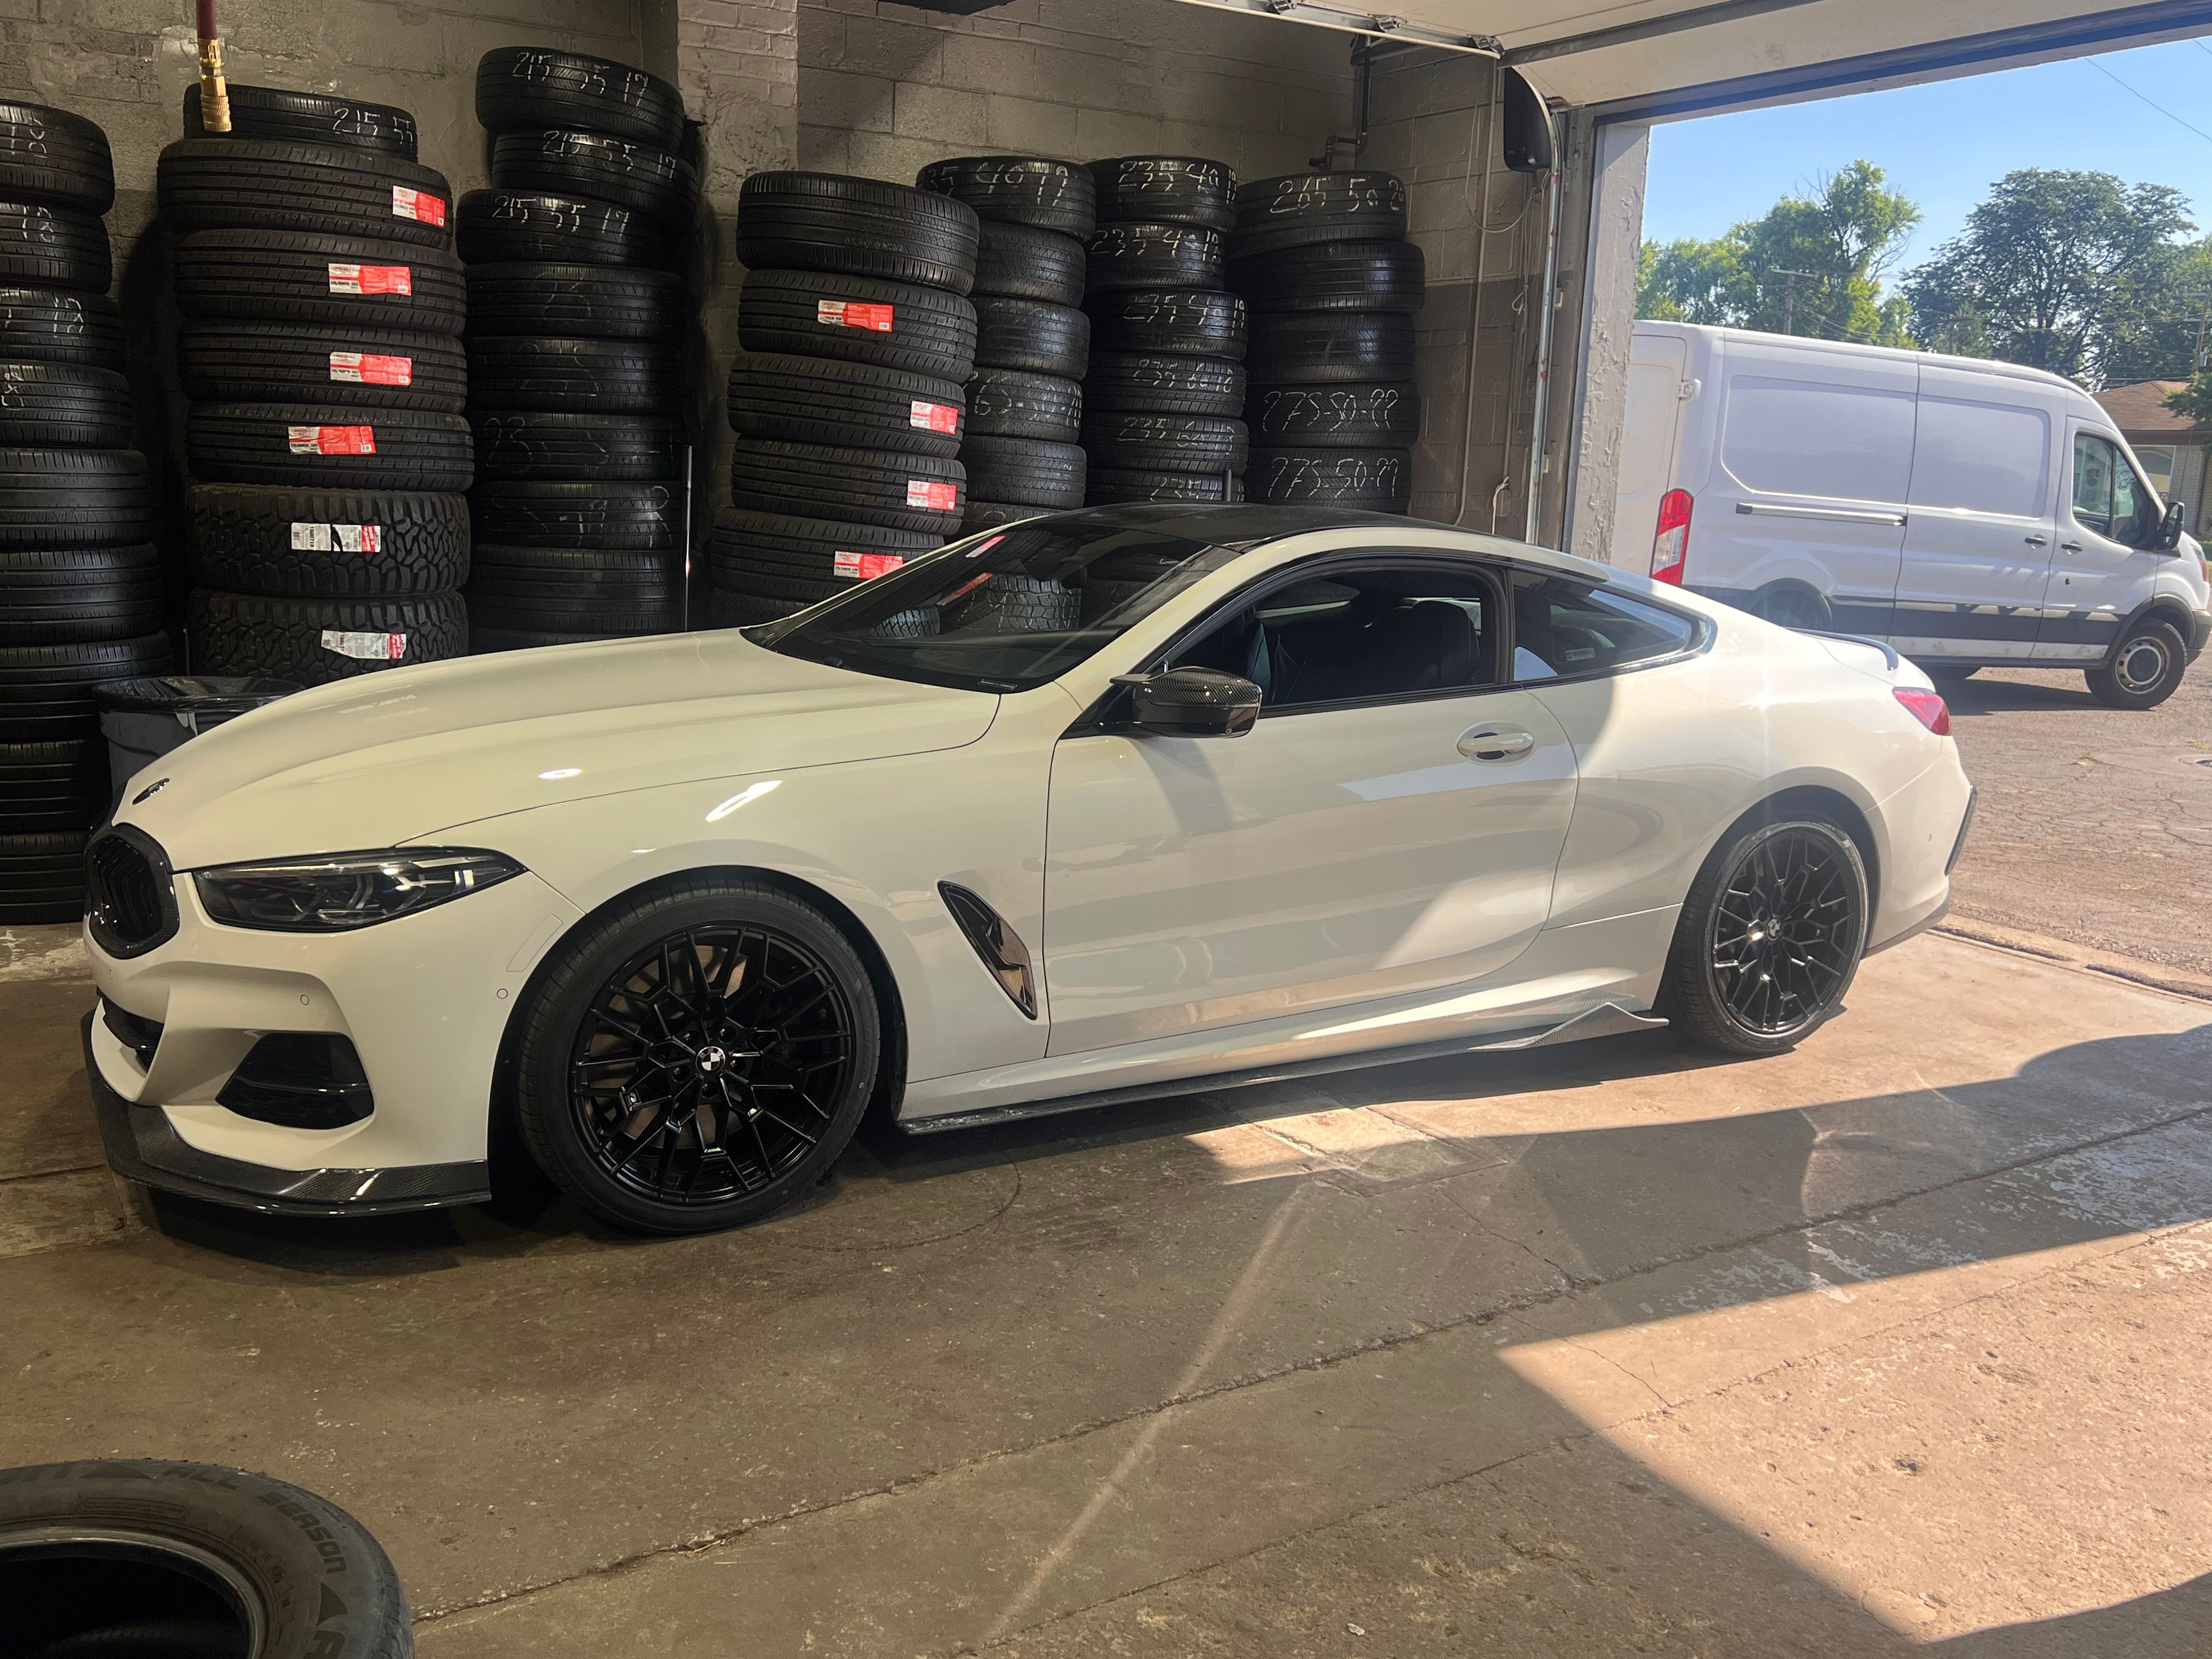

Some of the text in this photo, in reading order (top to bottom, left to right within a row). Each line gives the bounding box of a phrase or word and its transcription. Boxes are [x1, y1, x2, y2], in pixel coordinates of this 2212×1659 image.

[512, 52, 552, 82] 215
[623, 71, 648, 108] 17
[658, 154, 676, 184] 17
[1269, 176, 1331, 213] 265
[1347, 178, 1379, 212] 50
[492, 195, 537, 224] 215
[602, 206, 630, 238] 17
[256, 1491, 347, 1575] SEASON
